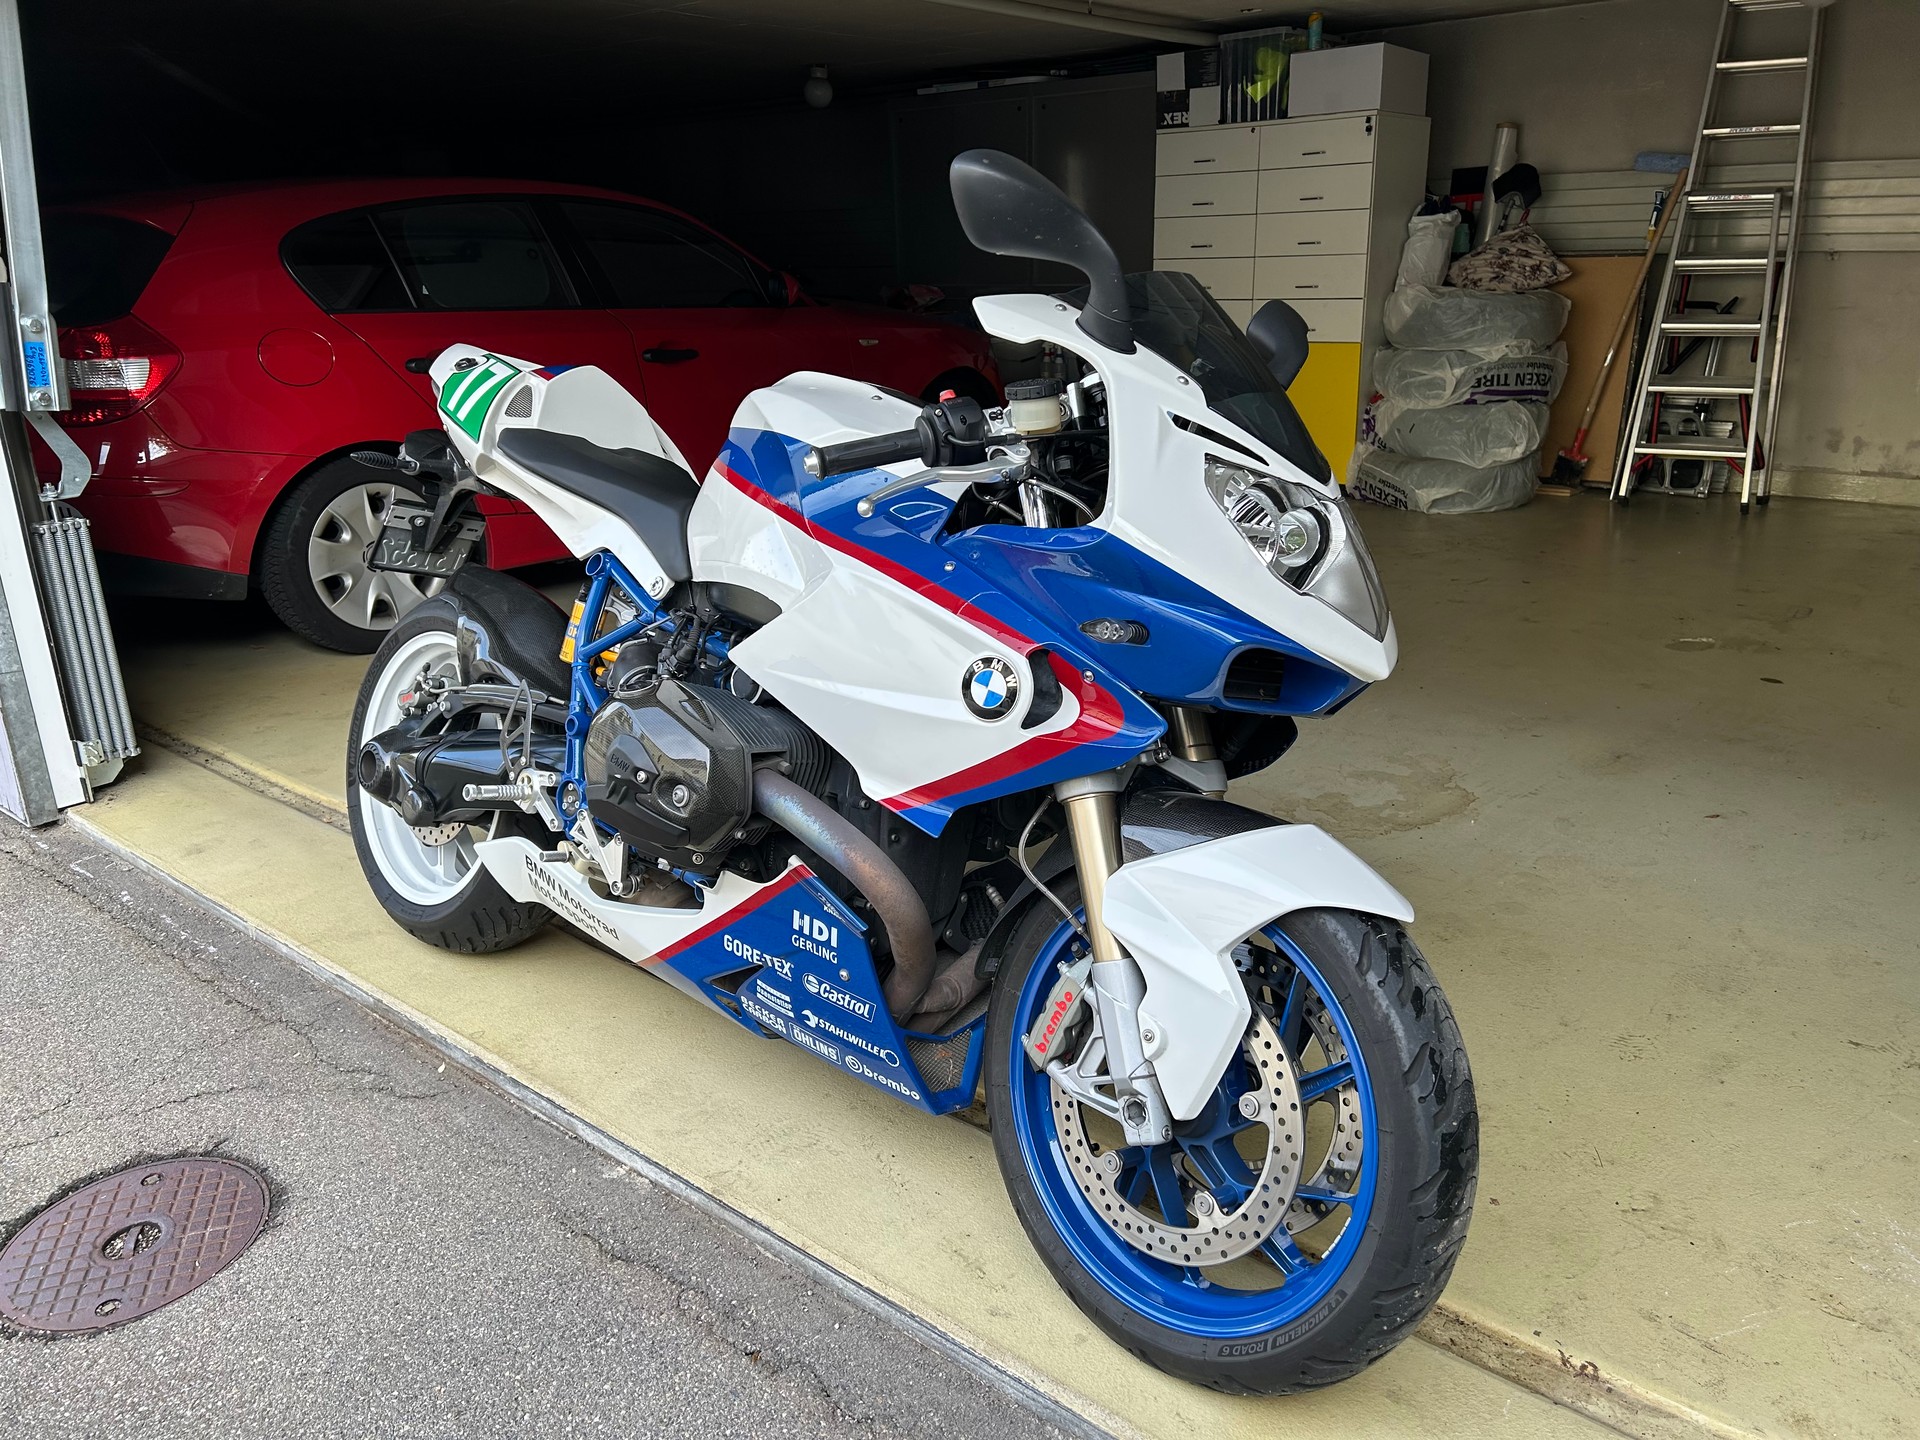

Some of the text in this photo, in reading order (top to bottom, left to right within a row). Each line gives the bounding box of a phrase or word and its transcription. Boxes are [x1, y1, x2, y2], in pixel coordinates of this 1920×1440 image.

[447, 358, 515, 422] 17
[1369, 483, 1409, 511] NEXEN
[973, 658, 1018, 688] BMW
[610, 753, 631, 773] BMW
[525, 854, 620, 941] BMW Motorrad
[528, 872, 602, 938] Motorsport
[792, 909, 838, 949] HDI
[723, 934, 794, 978] GORE-TEX
[791, 934, 838, 964] GERLING
[740, 995, 785, 1028] BECKER
[742, 1003, 787, 1035] CARBON
[819, 983, 871, 1019] Castrol
[818, 1017, 879, 1056] STAHLWILLE
[1034, 991, 1073, 1054] brembo
[793, 1025, 838, 1061] ÖHLINS
[863, 1064, 921, 1101] brembo
[1221, 1304, 1329, 1356] MICHELIN ROAD 6
